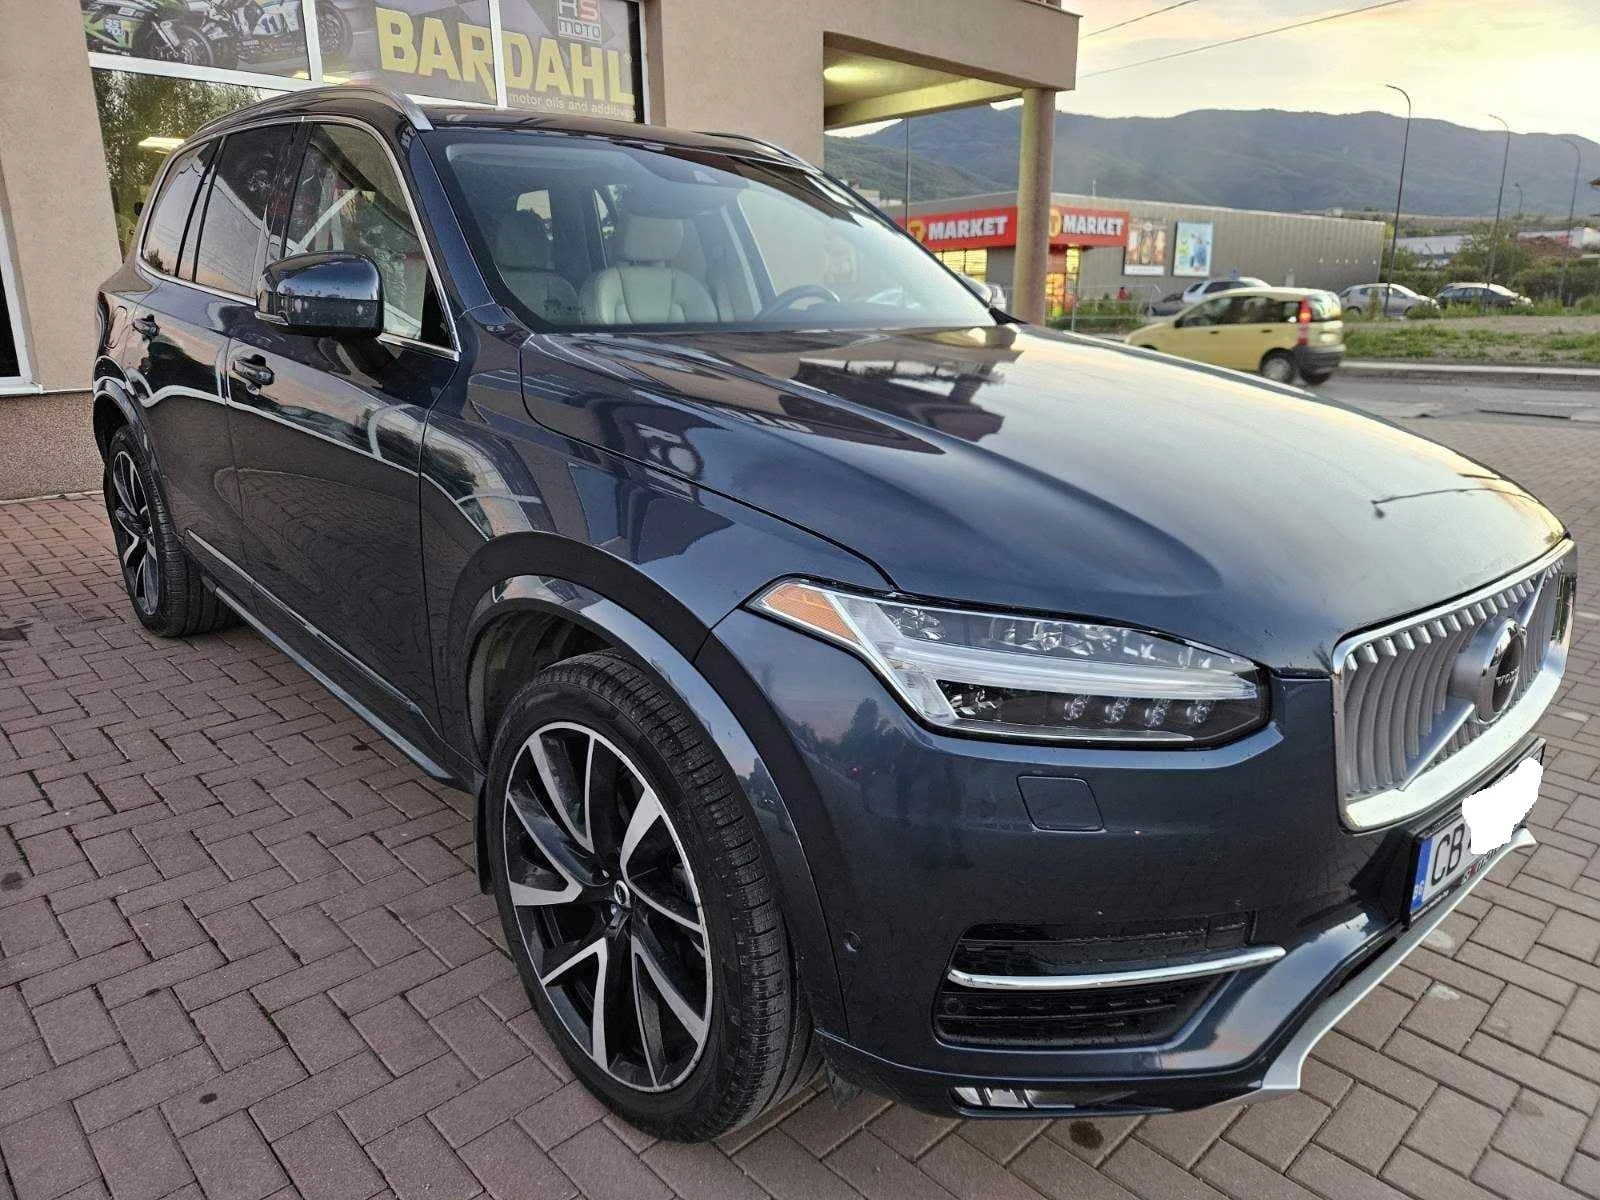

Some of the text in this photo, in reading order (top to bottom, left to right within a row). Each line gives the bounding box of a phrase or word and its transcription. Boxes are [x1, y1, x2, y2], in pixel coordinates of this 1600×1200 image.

[375, 6, 635, 106] BARDAHL
[510, 92, 542, 106] motor
[568, 100, 589, 113] and
[928, 216, 1008, 241] MARKET
[1062, 214, 1124, 236] MARKET
[1431, 823, 1466, 887] CB
